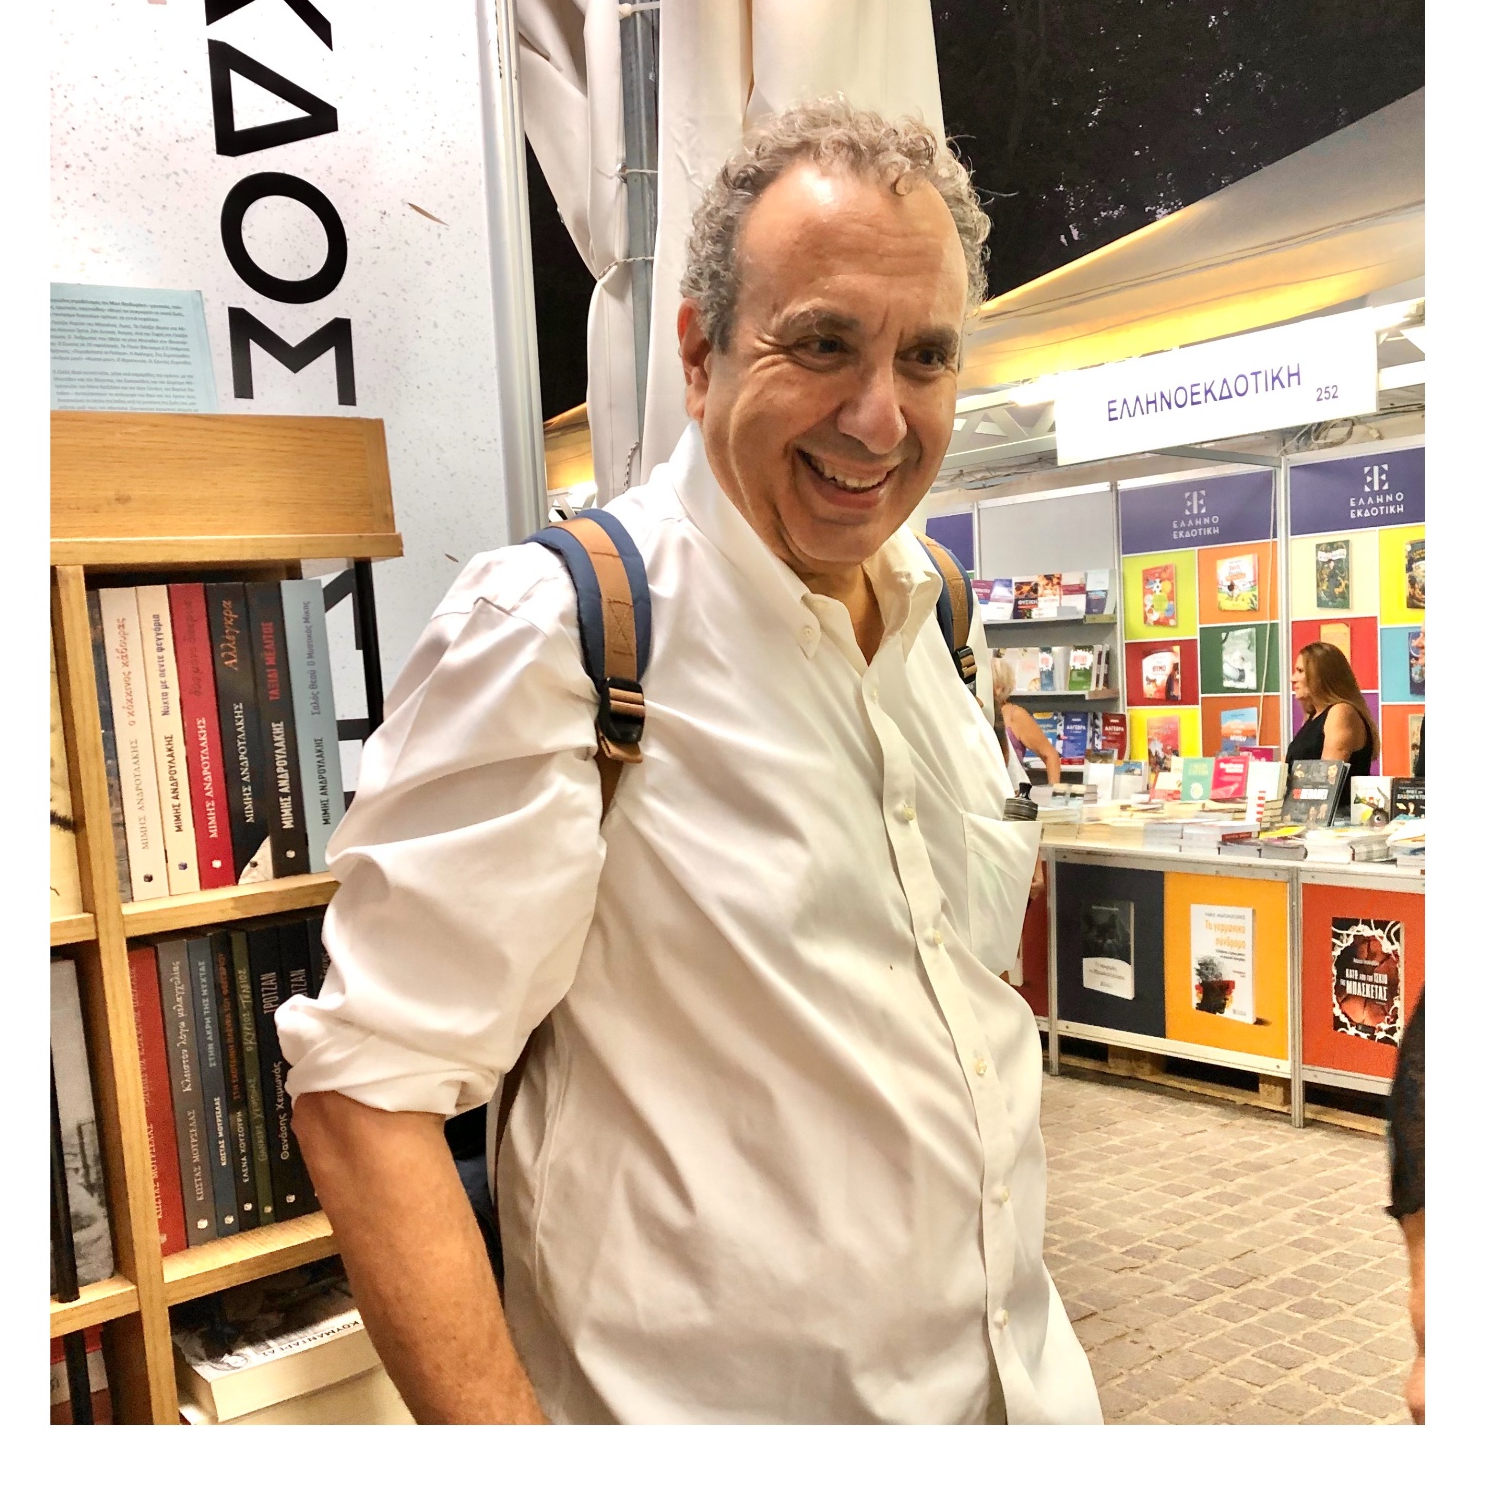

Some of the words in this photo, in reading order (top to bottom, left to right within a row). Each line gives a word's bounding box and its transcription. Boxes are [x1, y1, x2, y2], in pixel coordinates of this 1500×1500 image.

[1107, 363, 1302, 422] ΕΛΛΗΝΟΕΚΔΟΤΙΚΗ
[1315, 384, 1340, 402] 252
[1350, 492, 1404, 507] ΕΛΛΗΝΟ
[1350, 504, 1404, 518] ΕΚΔΟΤΙΚΗ
[1172, 516, 1220, 529] ΕΛΛΗΝΟ
[1172, 526, 1220, 540] ΕΚΔΟΤΙΚΗ
[196, 717, 215, 798] ΑΝΔΡΟΥΛΑΚΗΣ
[233, 702, 250, 783] ΑΝΔΡΟΥΛΑΚΗΣ
[272, 721, 290, 793] ΑΝΔΡΟΥΛΑΚΗΣ
[130, 738, 146, 812] ΑΝΔΡΟΥΛΑΚΗΣ
[164, 734, 180, 800] ΑΝΔΡΟΥΛΑΚΗΣ
[314, 737, 328, 796] ΑΝΔΡΟΥΛΑΚΗΣ
[172, 802, 184, 832] ΜΙΜΗΣ
[205, 800, 218, 838] ΜΙΜΗΣ
[242, 785, 255, 824] ΜΙΜΗΣ
[280, 796, 295, 829] ΜΙΜΗΣ
[320, 798, 331, 826] ΜΙΜΗΣ
[138, 814, 150, 850] ΜΙΜΗΣ
[187, 1109, 202, 1162] ΜΟΥΡΣΕΛΑΣ
[193, 1164, 205, 1202] ΚΩΣΤΑΣ
